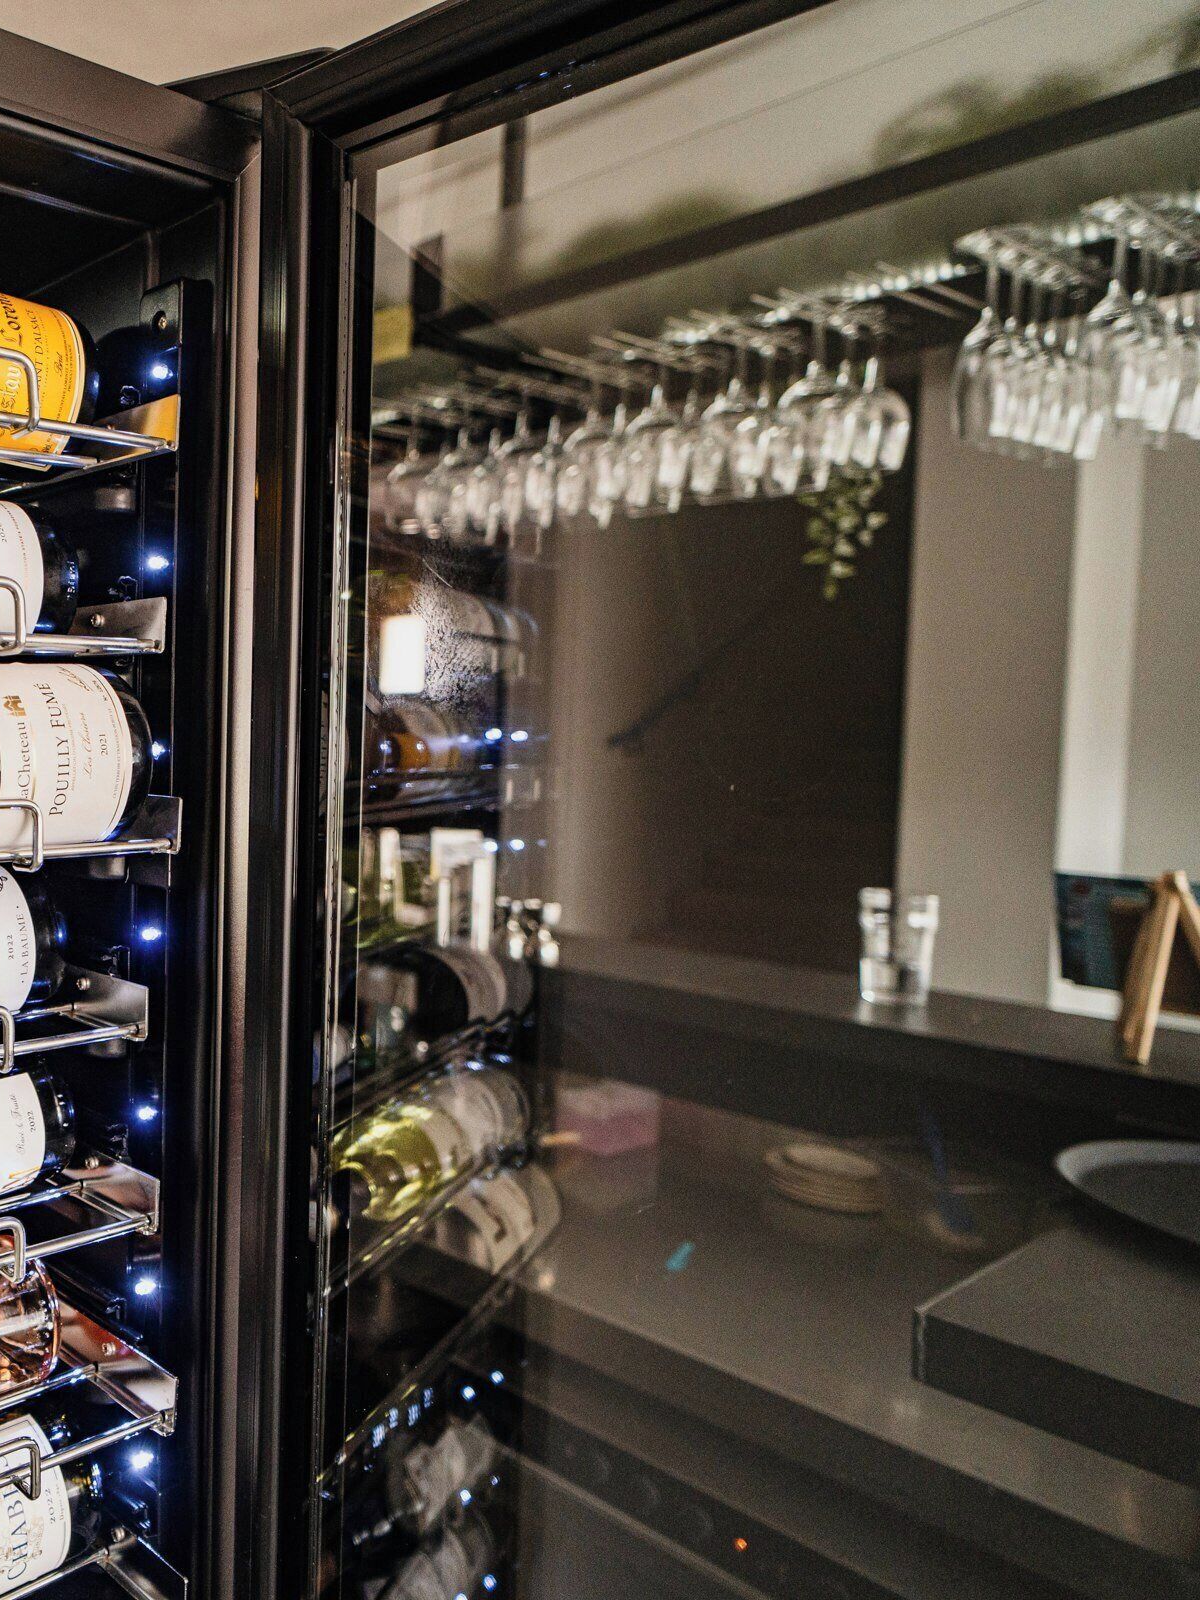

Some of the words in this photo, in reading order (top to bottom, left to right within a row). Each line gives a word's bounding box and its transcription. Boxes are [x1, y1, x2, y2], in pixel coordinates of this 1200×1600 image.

[33, 681, 66, 728] FUMÉ
[17, 721, 31, 800] aCheteau
[98, 733, 109, 756] 2021
[48, 736, 71, 815] POUILLY
[6, 934, 15, 960] 2022
[15, 914, 29, 958] BAUME
[20, 961, 29, 976] LA
[27, 1111, 36, 1143] 2022
[44, 1488, 56, 1525] 2022
